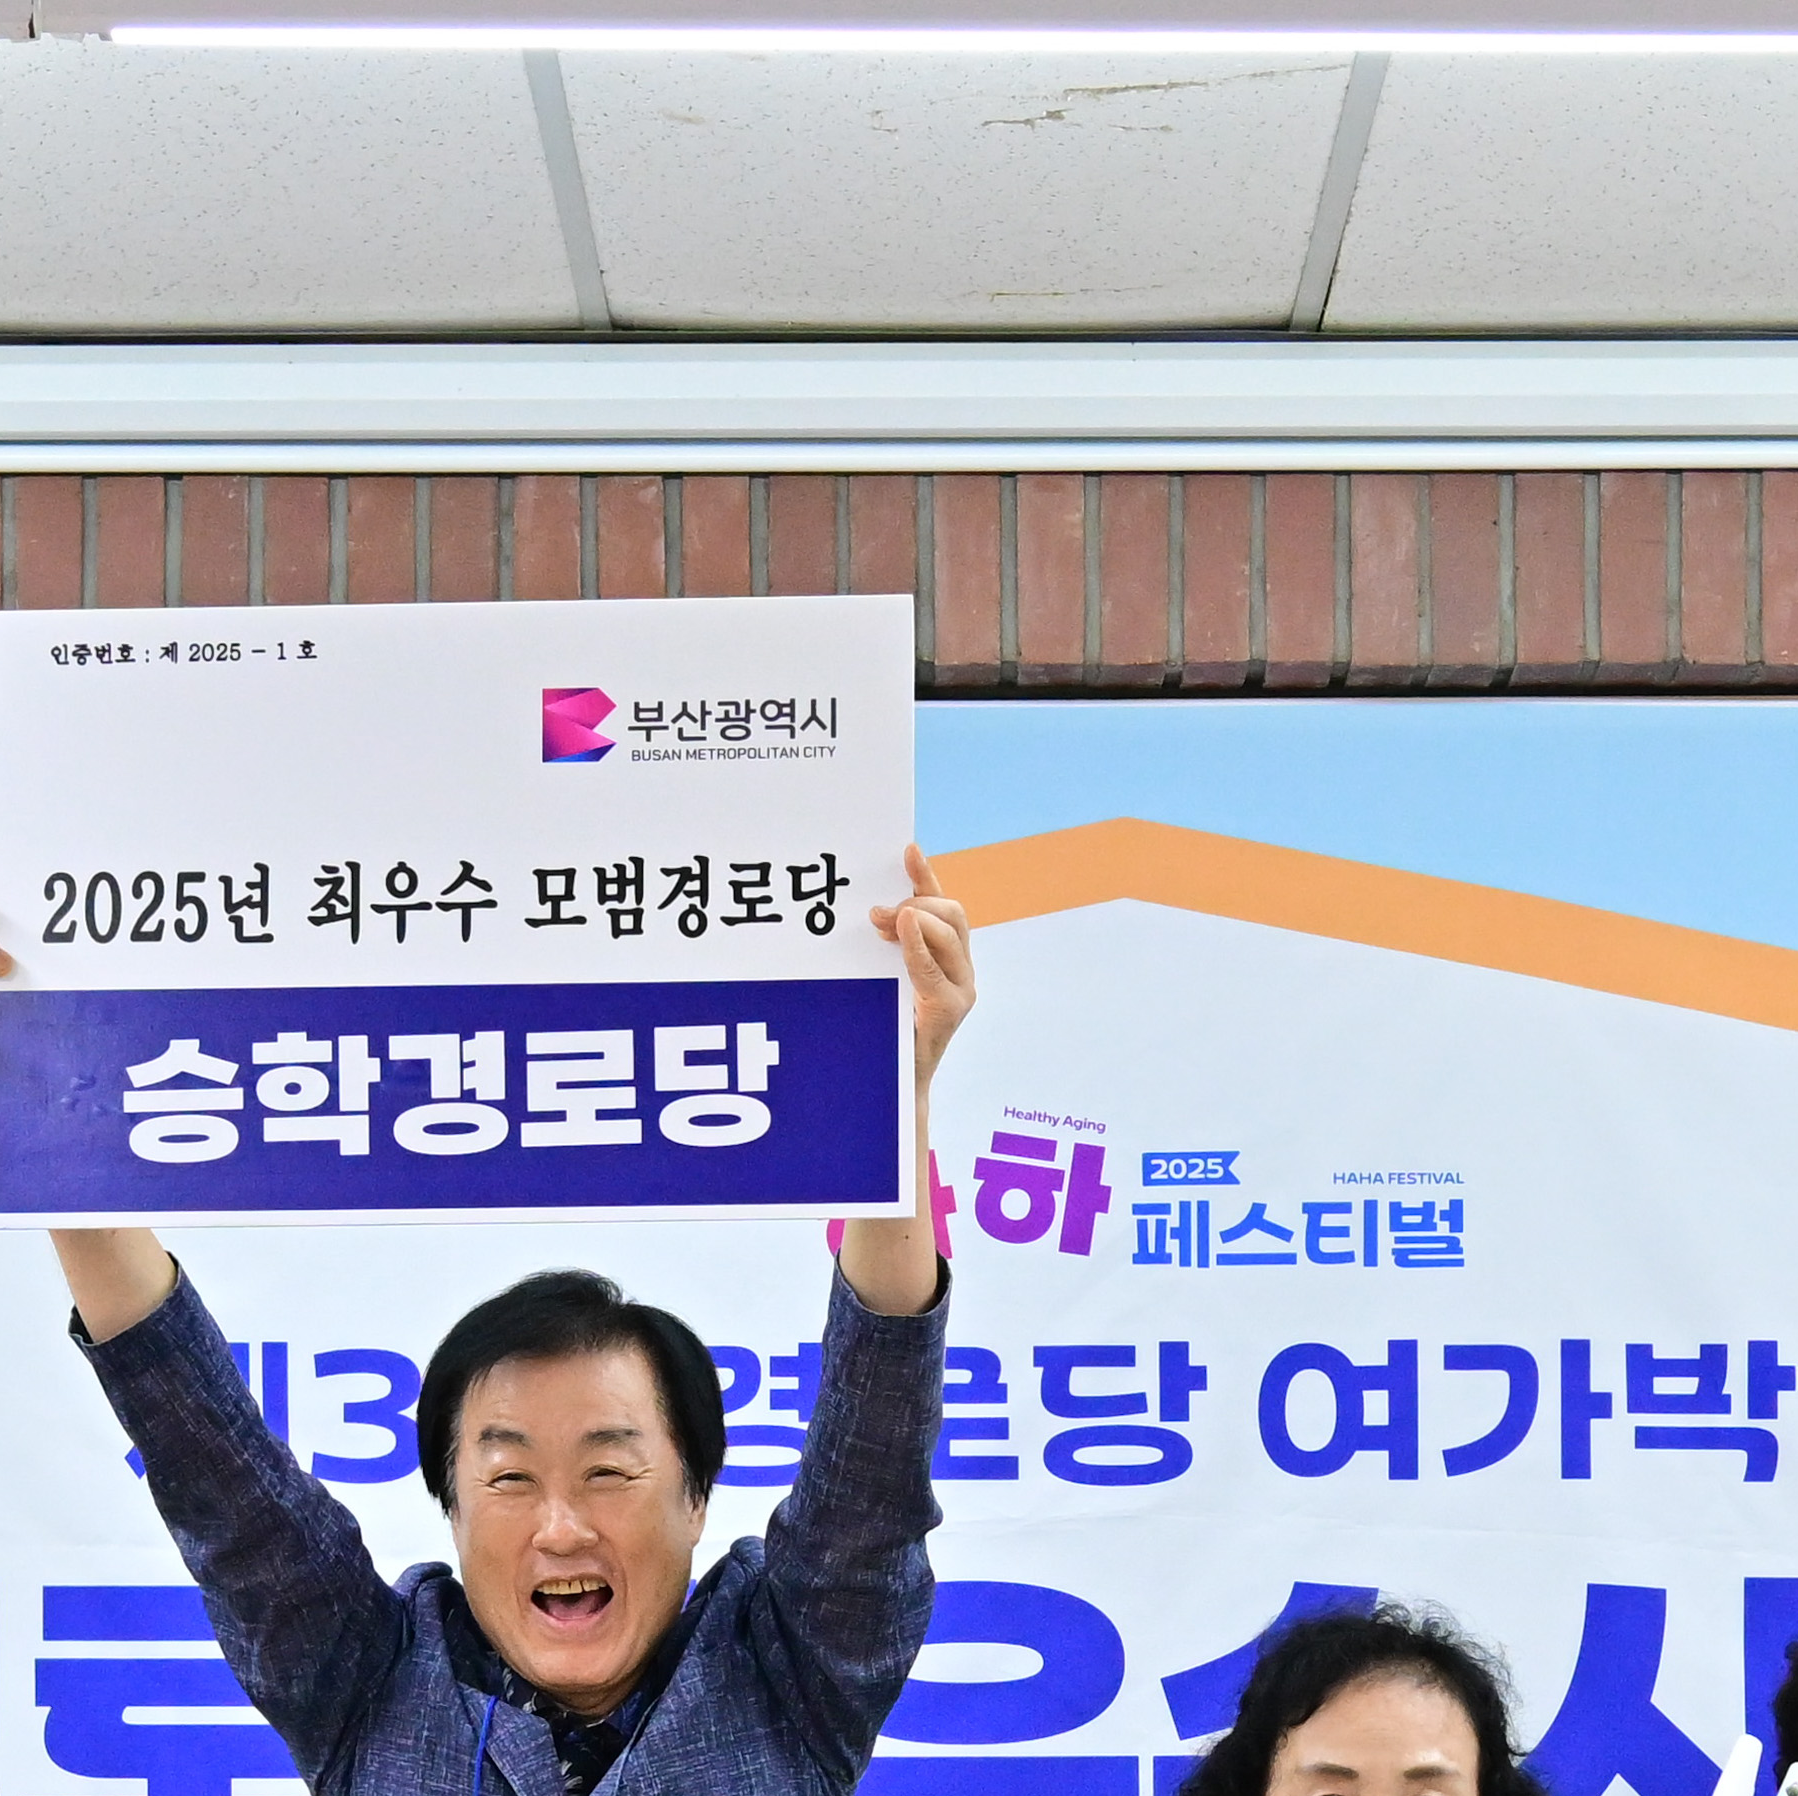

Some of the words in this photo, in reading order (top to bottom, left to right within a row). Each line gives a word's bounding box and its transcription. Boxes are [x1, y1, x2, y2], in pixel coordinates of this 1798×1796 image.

[50, 643, 136, 665] 인증번호
[159, 641, 179, 664] 제
[188, 642, 242, 662] 2025
[277, 642, 287, 660] 1
[296, 640, 318, 660] 호
[627, 697, 838, 743] 부산광역시
[631, 748, 682, 762] BUSAN
[685, 746, 801, 761] METROPOLITAN
[803, 745, 837, 759] CITY
[42, 861, 276, 946] 2025년
[306, 859, 499, 946] 최우수
[522, 851, 851, 940] 모범경로당
[122, 1020, 781, 1165] 승학경로당
[1002, 1105, 1060, 1129] Healthy
[1061, 1113, 1107, 1136] Aging
[1149, 1158, 1225, 1181] 2025
[1332, 1171, 1383, 1185] HAHA
[1386, 1171, 1466, 1185] FESTIVAL
[1131, 1198, 1466, 1269] 페스티벌
